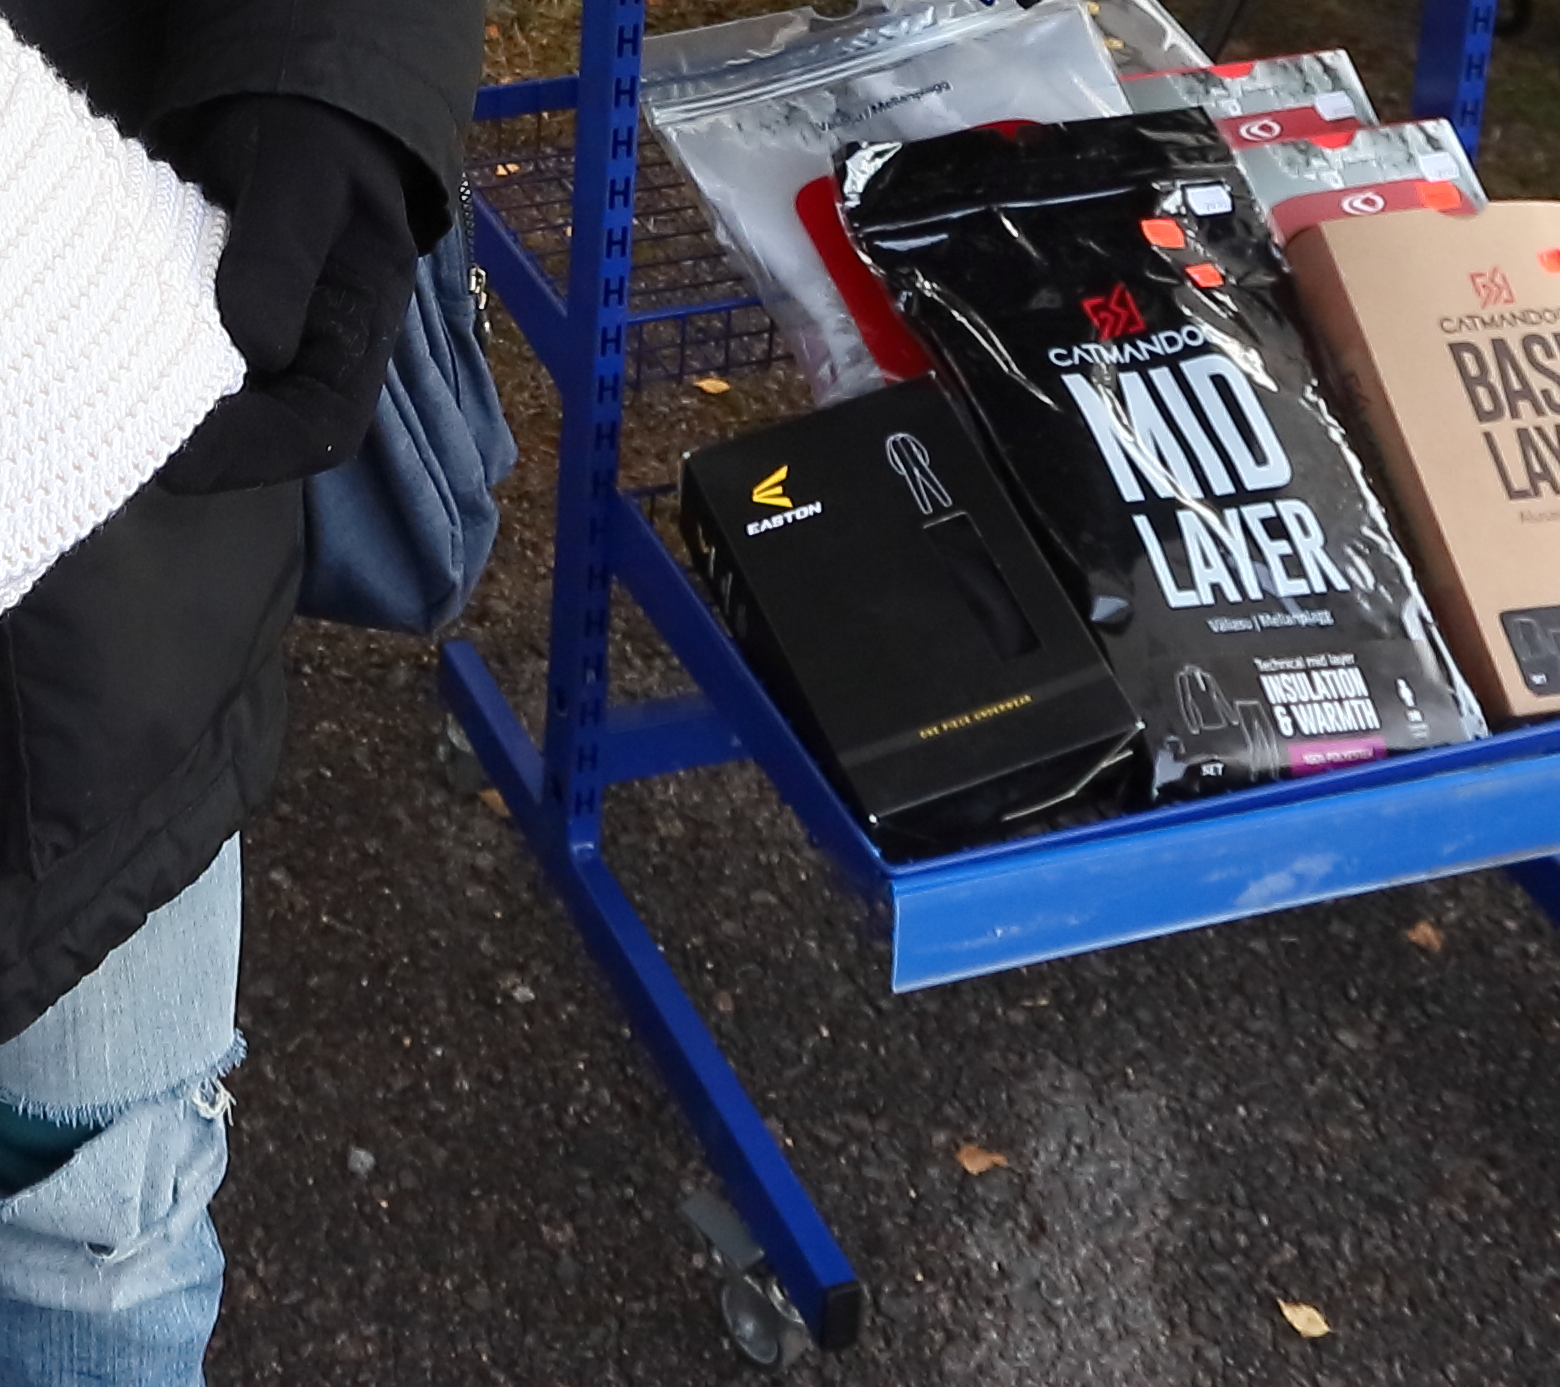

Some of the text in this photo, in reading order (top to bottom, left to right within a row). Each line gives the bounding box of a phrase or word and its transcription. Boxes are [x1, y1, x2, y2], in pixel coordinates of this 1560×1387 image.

[1061, 353, 1292, 503] MID
[746, 501, 823, 537] EASTON
[1132, 496, 1351, 610] LAYER
[1254, 657, 1303, 672] Technical
[1260, 666, 1370, 706] INSULATION
[1271, 704, 1293, 738] &
[1290, 698, 1382, 737] WARMTH
[1201, 764, 1225, 777] SET
